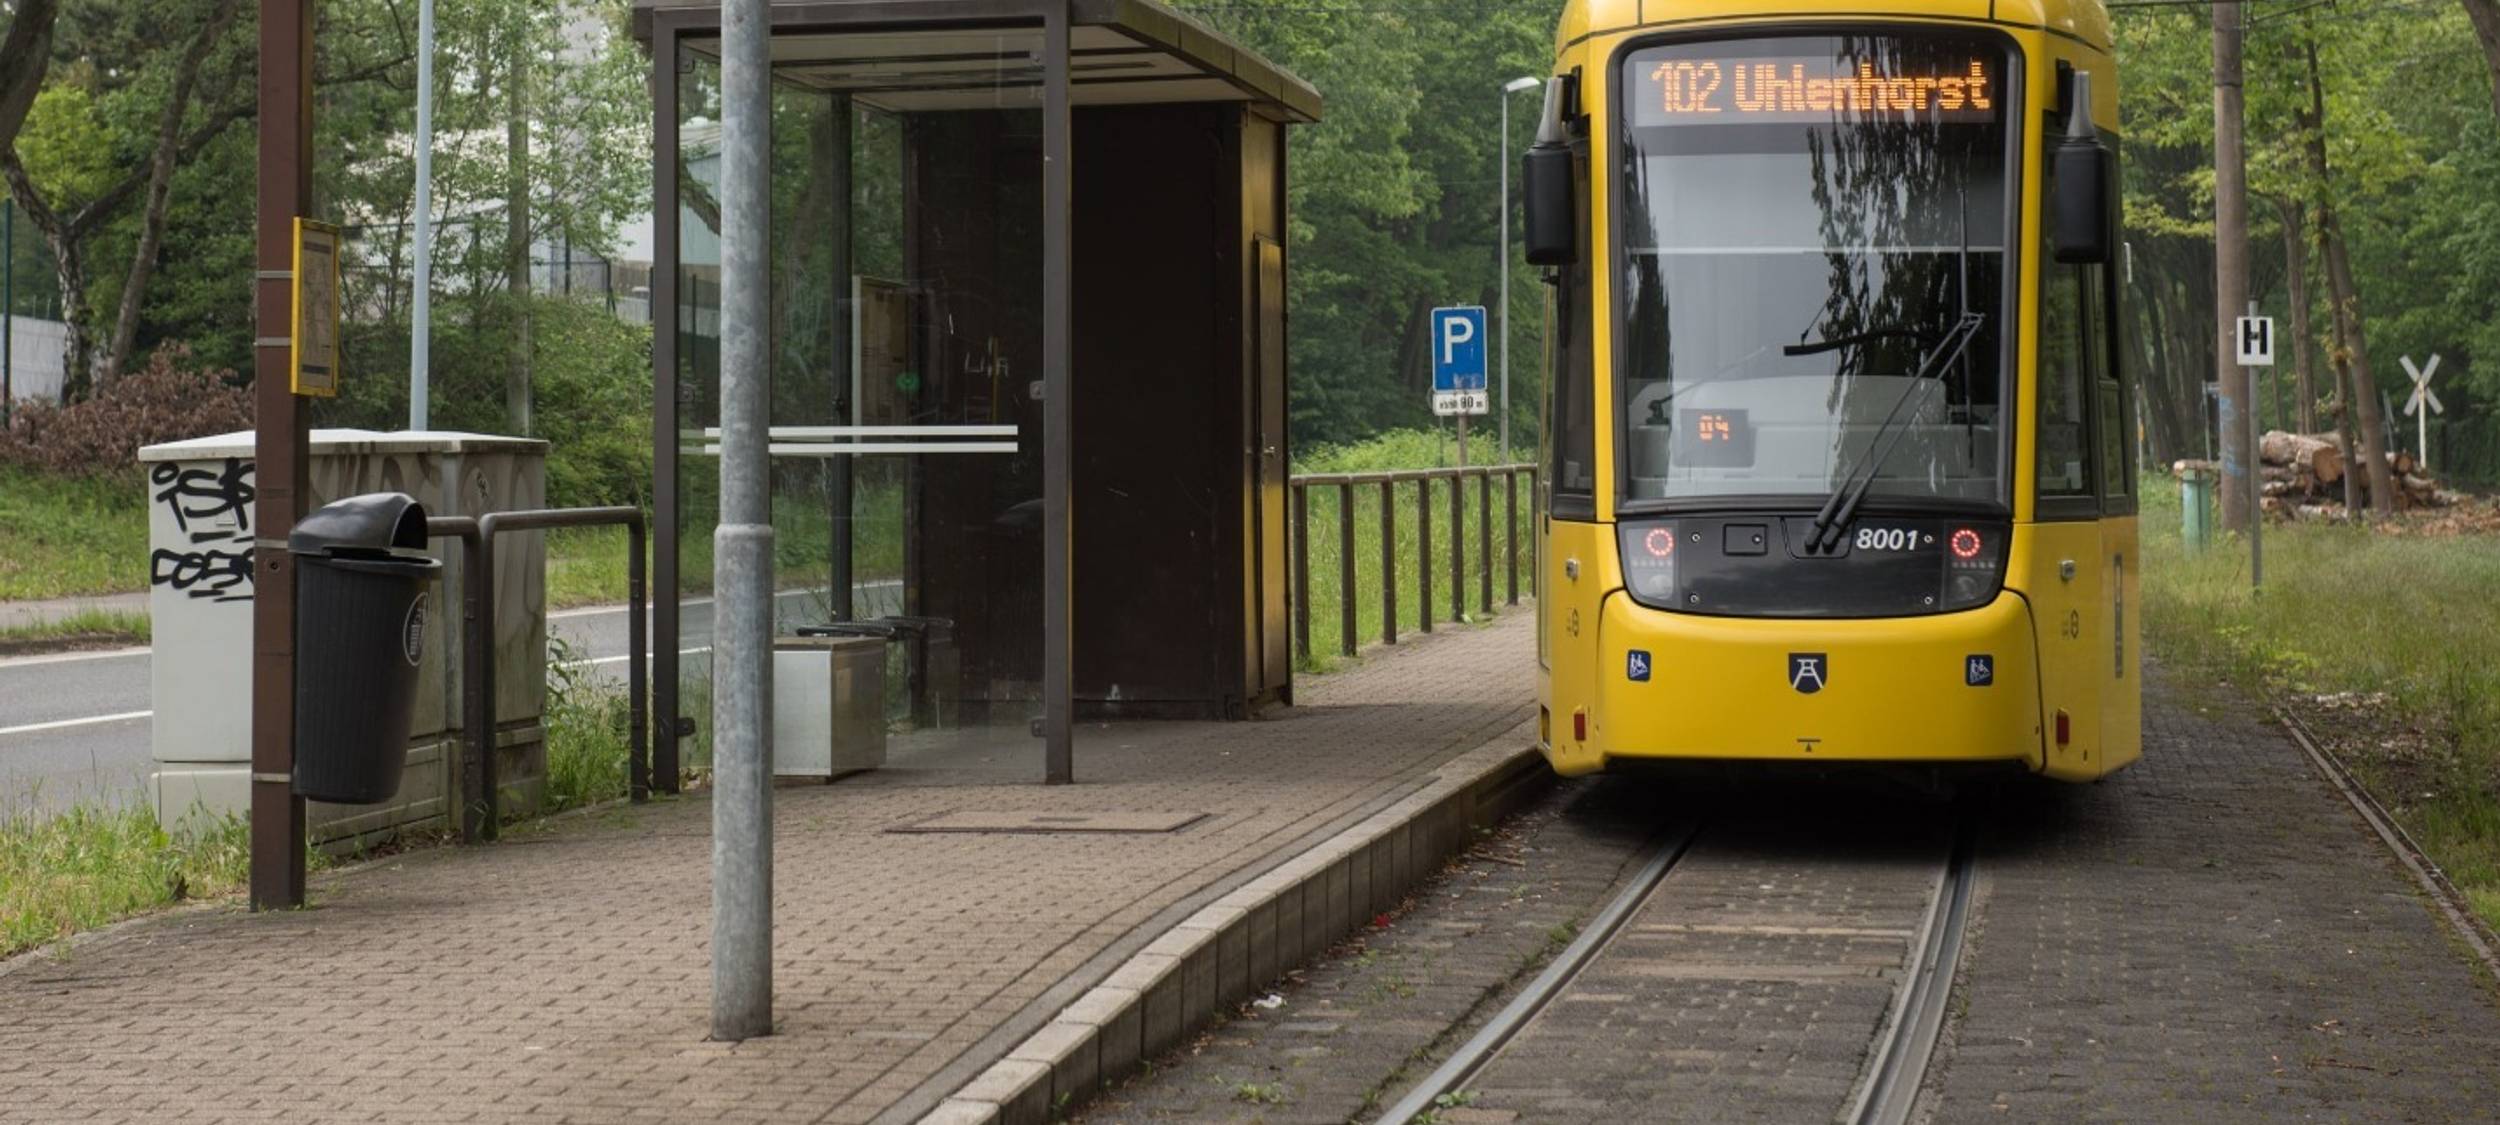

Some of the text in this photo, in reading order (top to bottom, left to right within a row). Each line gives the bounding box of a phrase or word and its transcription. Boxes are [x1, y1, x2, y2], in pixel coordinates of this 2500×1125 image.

[1652, 60, 1991, 112] 102 Uhlenhorst
[1444, 316, 1474, 364] P
[2243, 319, 2267, 355] H
[1856, 528, 1919, 551] 8001
